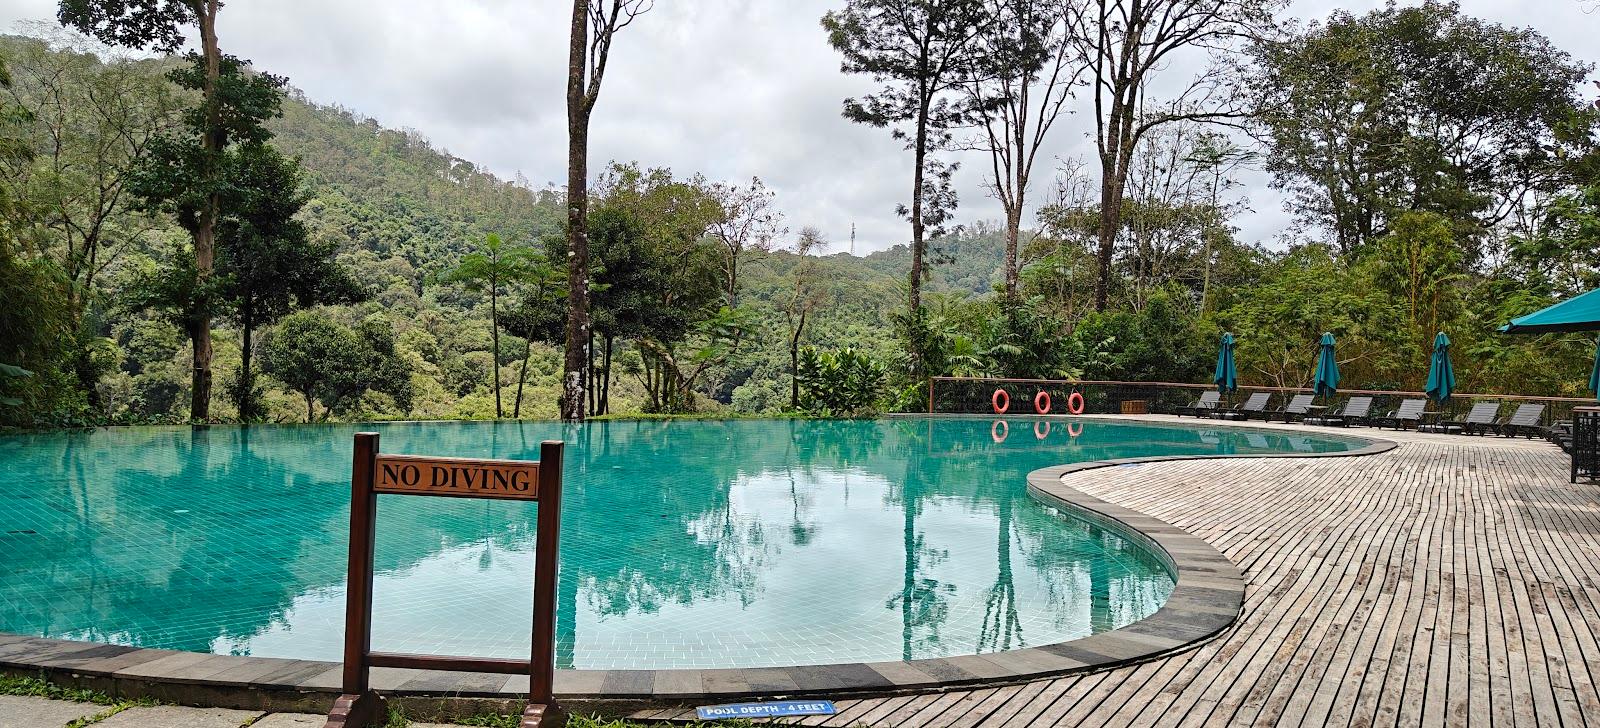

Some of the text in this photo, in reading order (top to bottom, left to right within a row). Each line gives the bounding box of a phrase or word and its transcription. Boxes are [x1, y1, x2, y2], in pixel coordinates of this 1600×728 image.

[382, 464, 530, 491] NO DIVING
[706, 708, 738, 716] POOL
[740, 705, 779, 714] DEPTH
[788, 704, 796, 712] 4
[799, 703, 825, 711] FEET
